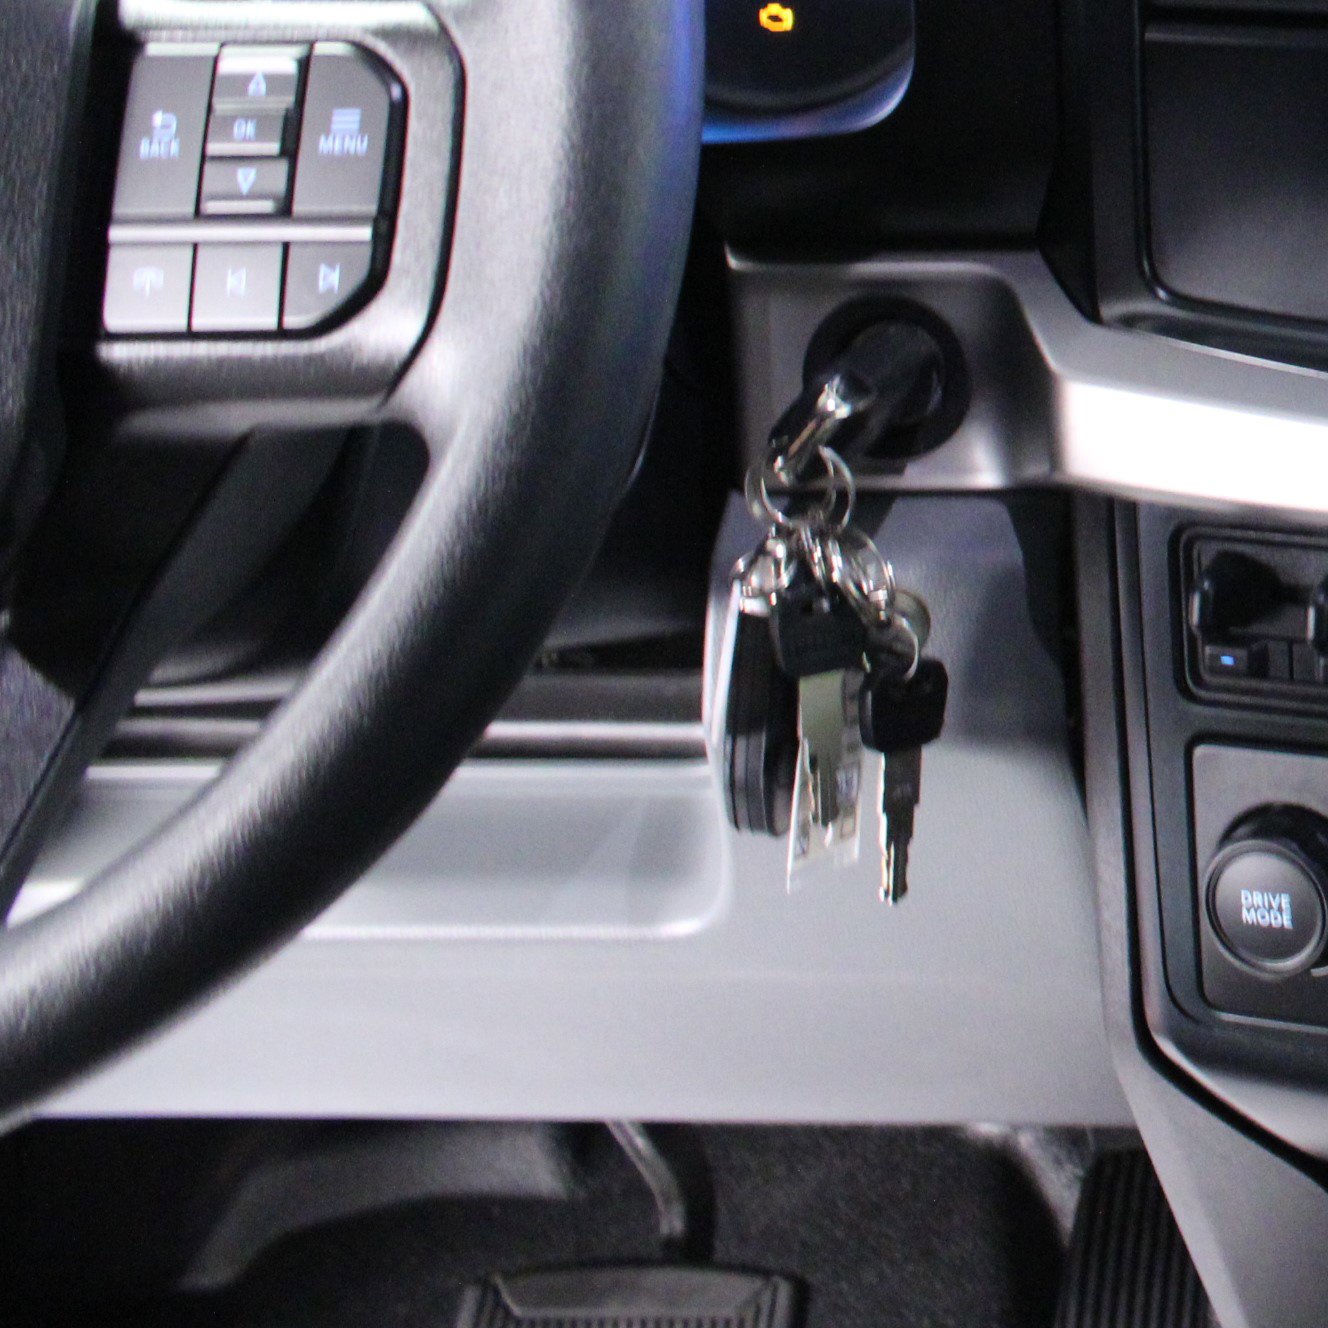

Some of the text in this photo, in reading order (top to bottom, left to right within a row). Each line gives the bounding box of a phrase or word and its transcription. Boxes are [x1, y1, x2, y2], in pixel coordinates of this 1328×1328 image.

[232, 118, 257, 142] OK
[139, 138, 181, 159] BACK
[318, 133, 369, 157] MENU
[1240, 888, 1291, 911] DRIVE
[1241, 907, 1293, 930] MODE
